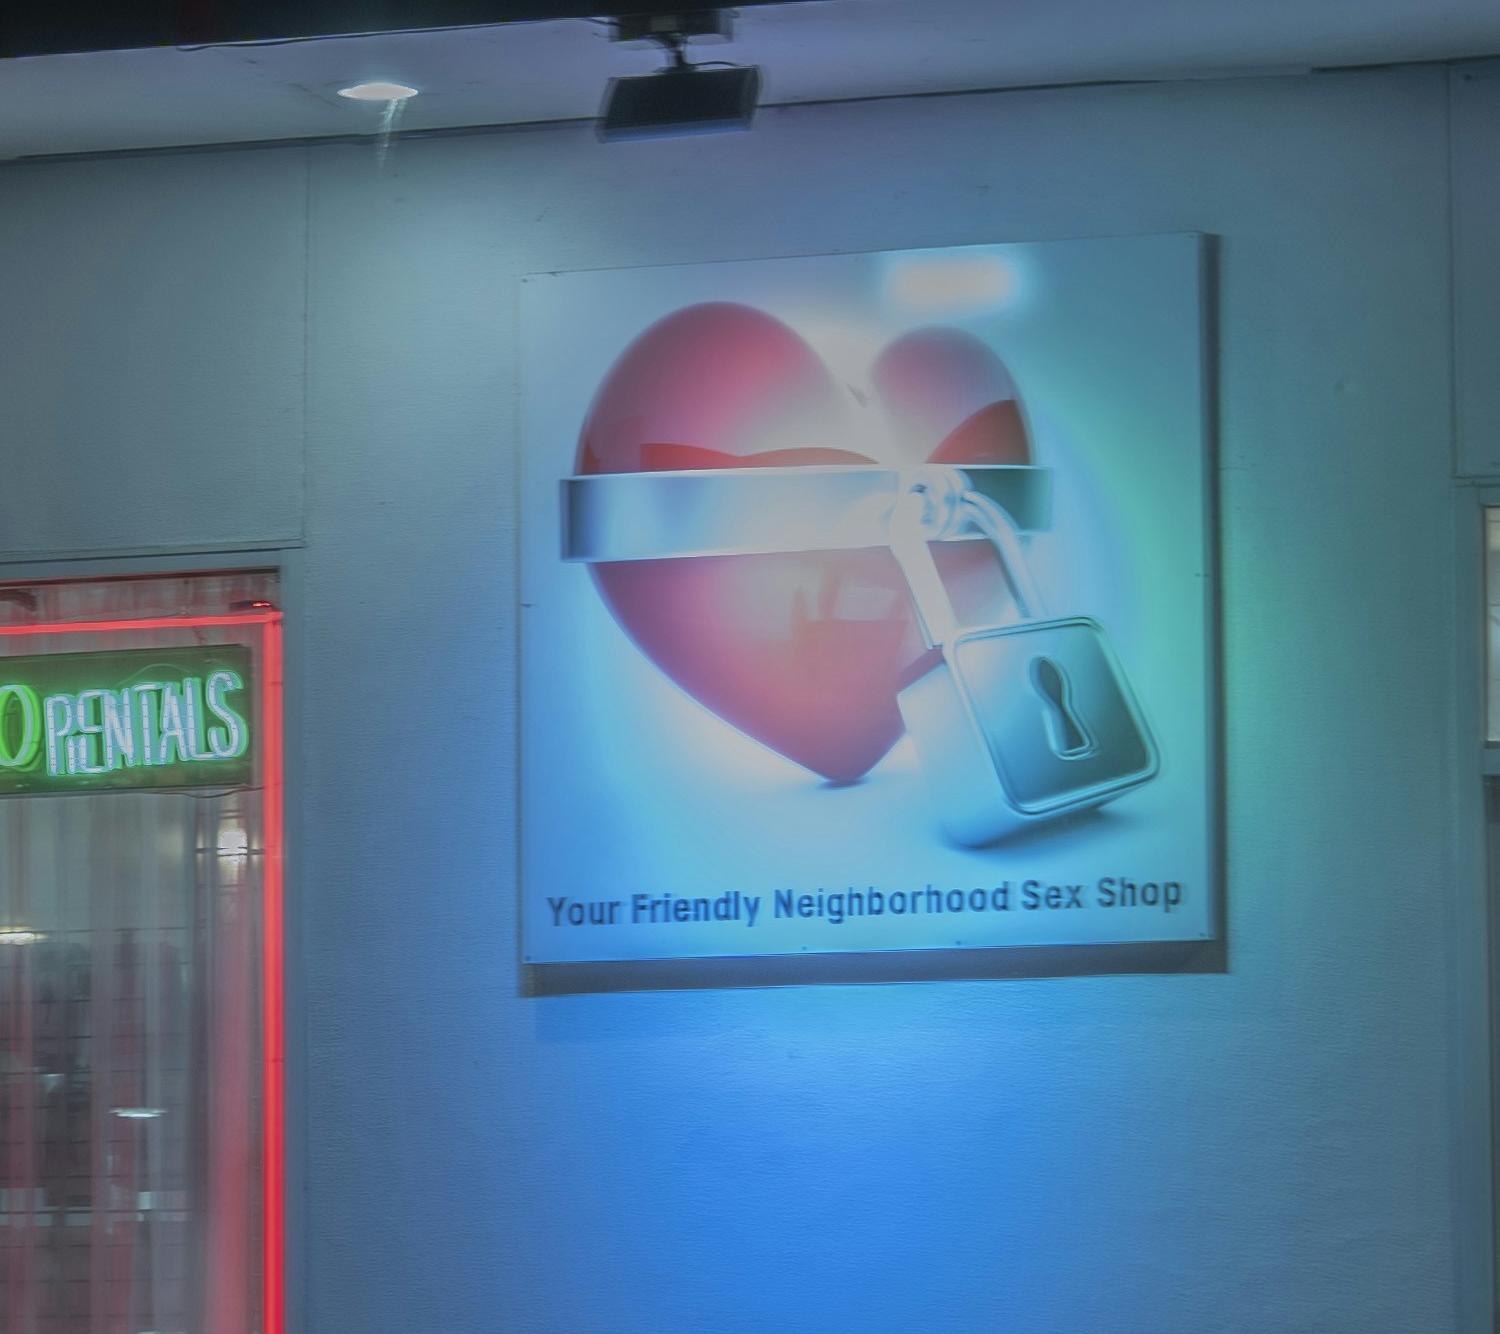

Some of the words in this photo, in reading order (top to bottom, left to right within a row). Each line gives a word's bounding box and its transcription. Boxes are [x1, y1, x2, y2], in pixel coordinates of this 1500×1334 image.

[43, 670, 248, 777] RENTALS
[547, 896, 620, 927] Your
[631, 890, 761, 927] Friendly
[774, 880, 1010, 924] Neighborhood
[1021, 879, 1085, 911] Sex
[1098, 876, 1182, 914] Shop
